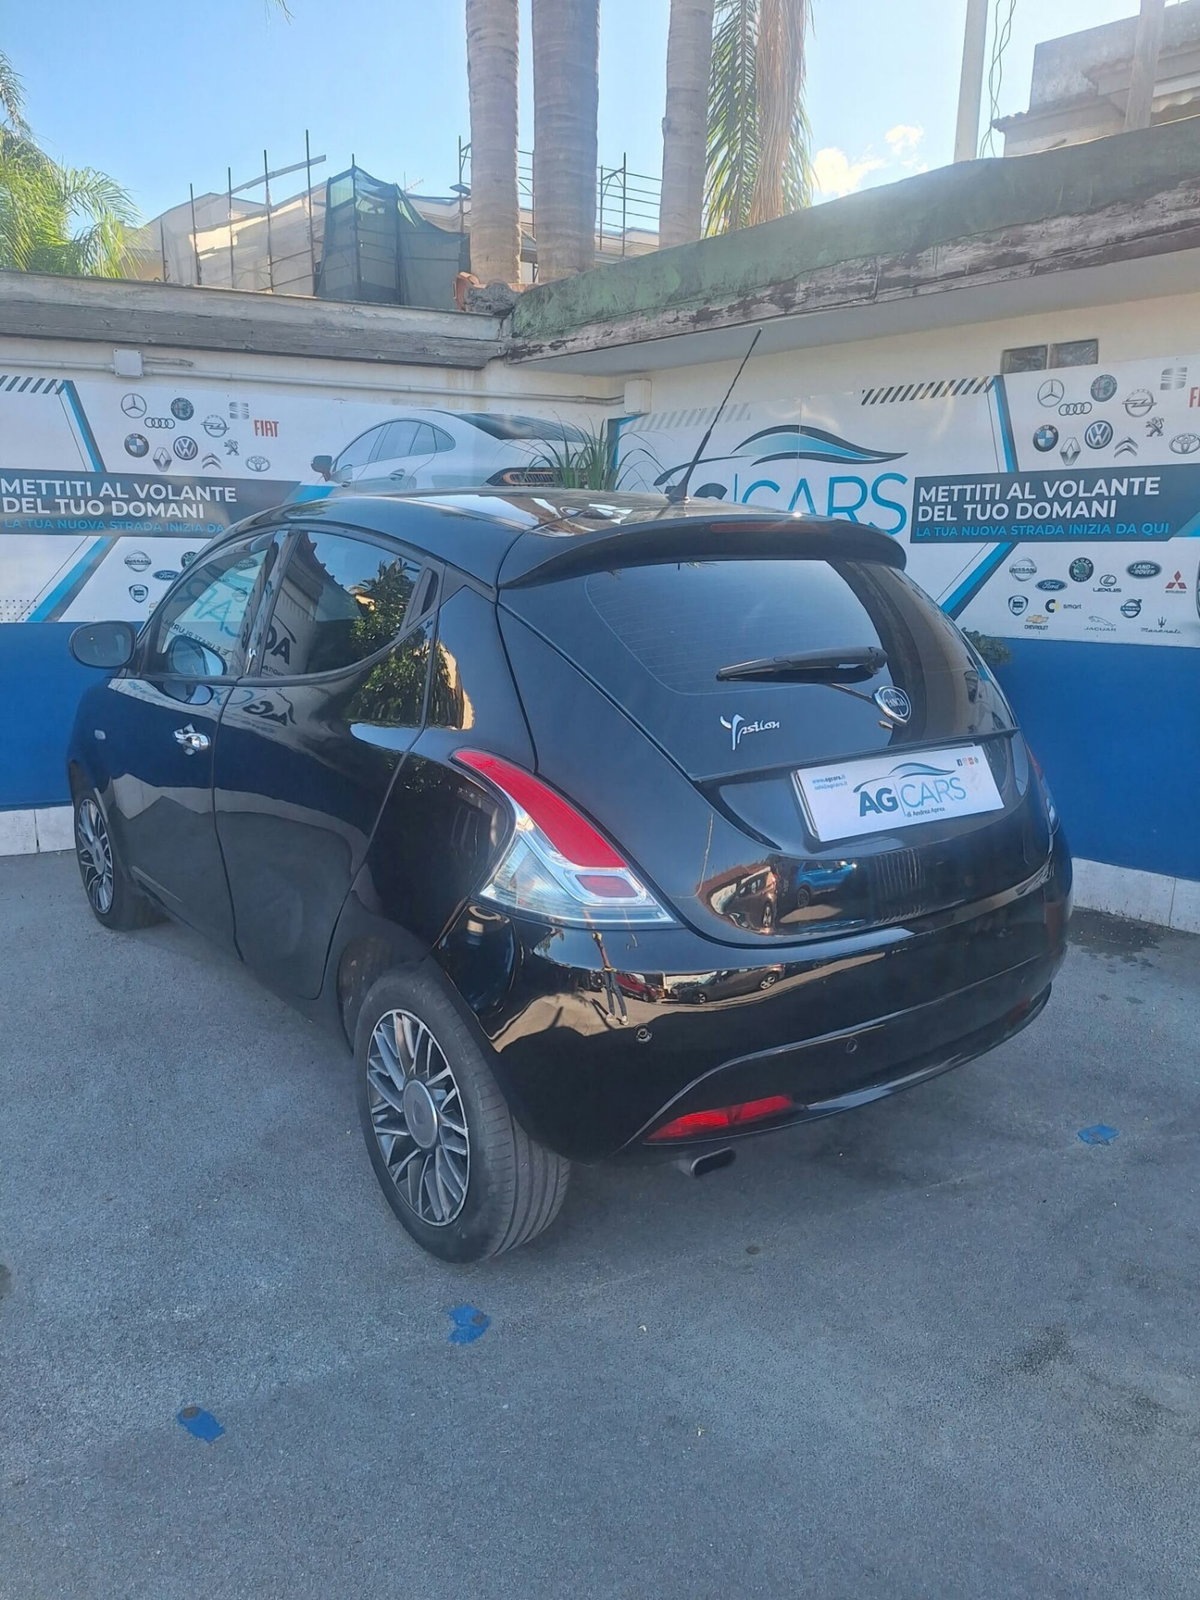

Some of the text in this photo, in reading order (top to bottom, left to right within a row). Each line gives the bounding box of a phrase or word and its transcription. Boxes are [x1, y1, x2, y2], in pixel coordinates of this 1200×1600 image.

[254, 419, 279, 437] FIAT
[0, 478, 237, 502] METTITI AL VOLANTE
[919, 476, 1161, 503] METTITI AL VOLANTE
[2, 497, 204, 518] DEL TUO DOMANI
[918, 500, 1116, 521] DEL TUO DOMANI
[5, 519, 225, 533] LA TUA NUOVA STRADA INIZIA DA
[916, 523, 1169, 536] LA TUA NUOVA STRADA INIZIA DA QUI
[720, 714, 780, 751] Ypsilon
[860, 777, 967, 817] AG CARS
